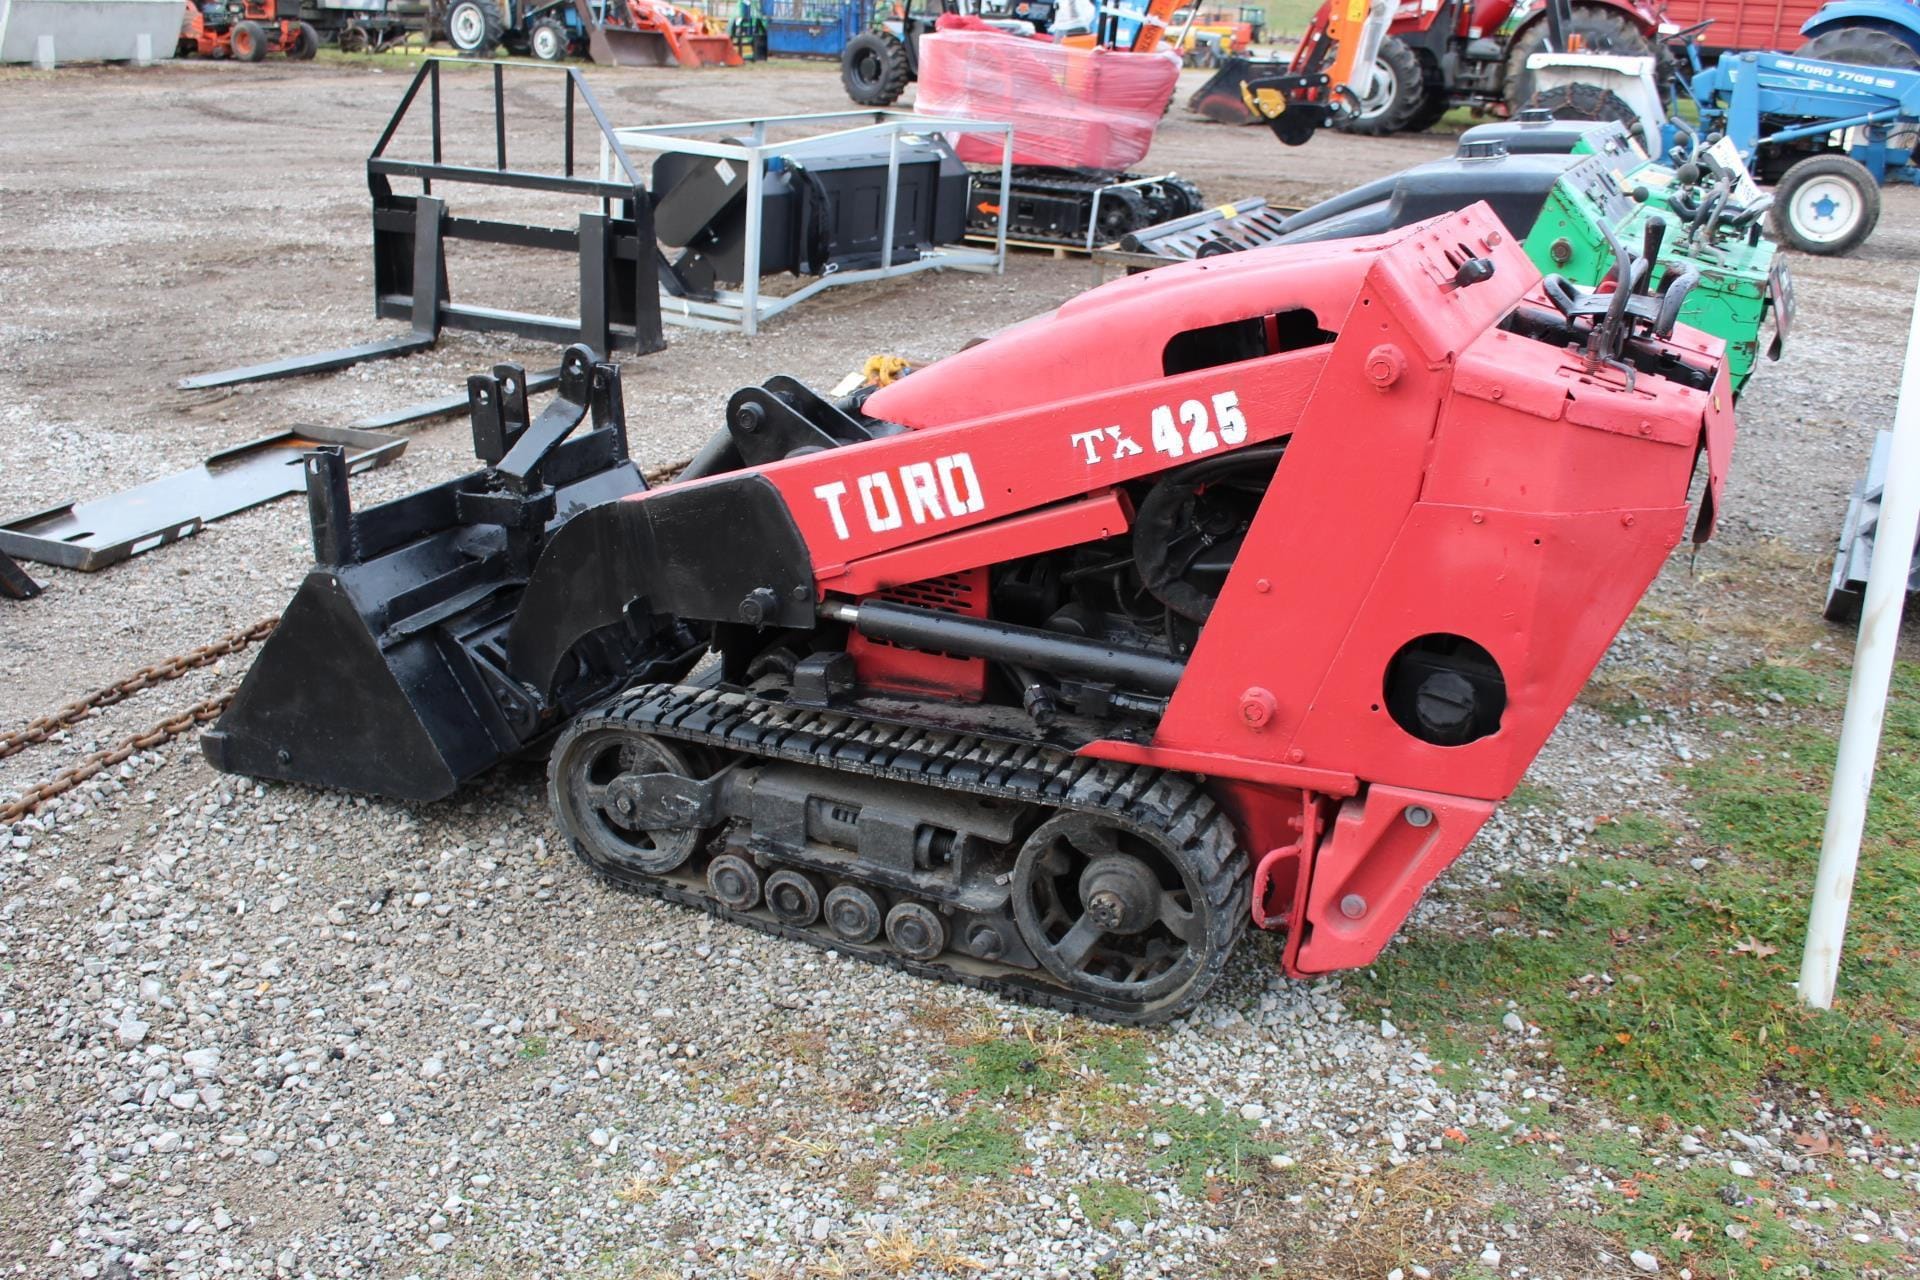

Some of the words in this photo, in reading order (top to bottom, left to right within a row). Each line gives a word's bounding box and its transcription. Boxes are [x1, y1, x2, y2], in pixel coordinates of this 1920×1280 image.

[1795, 63, 1833, 78] FORD
[813, 452, 985, 541] TORO
[1071, 424, 1144, 466] TX
[1151, 390, 1248, 459] 425
